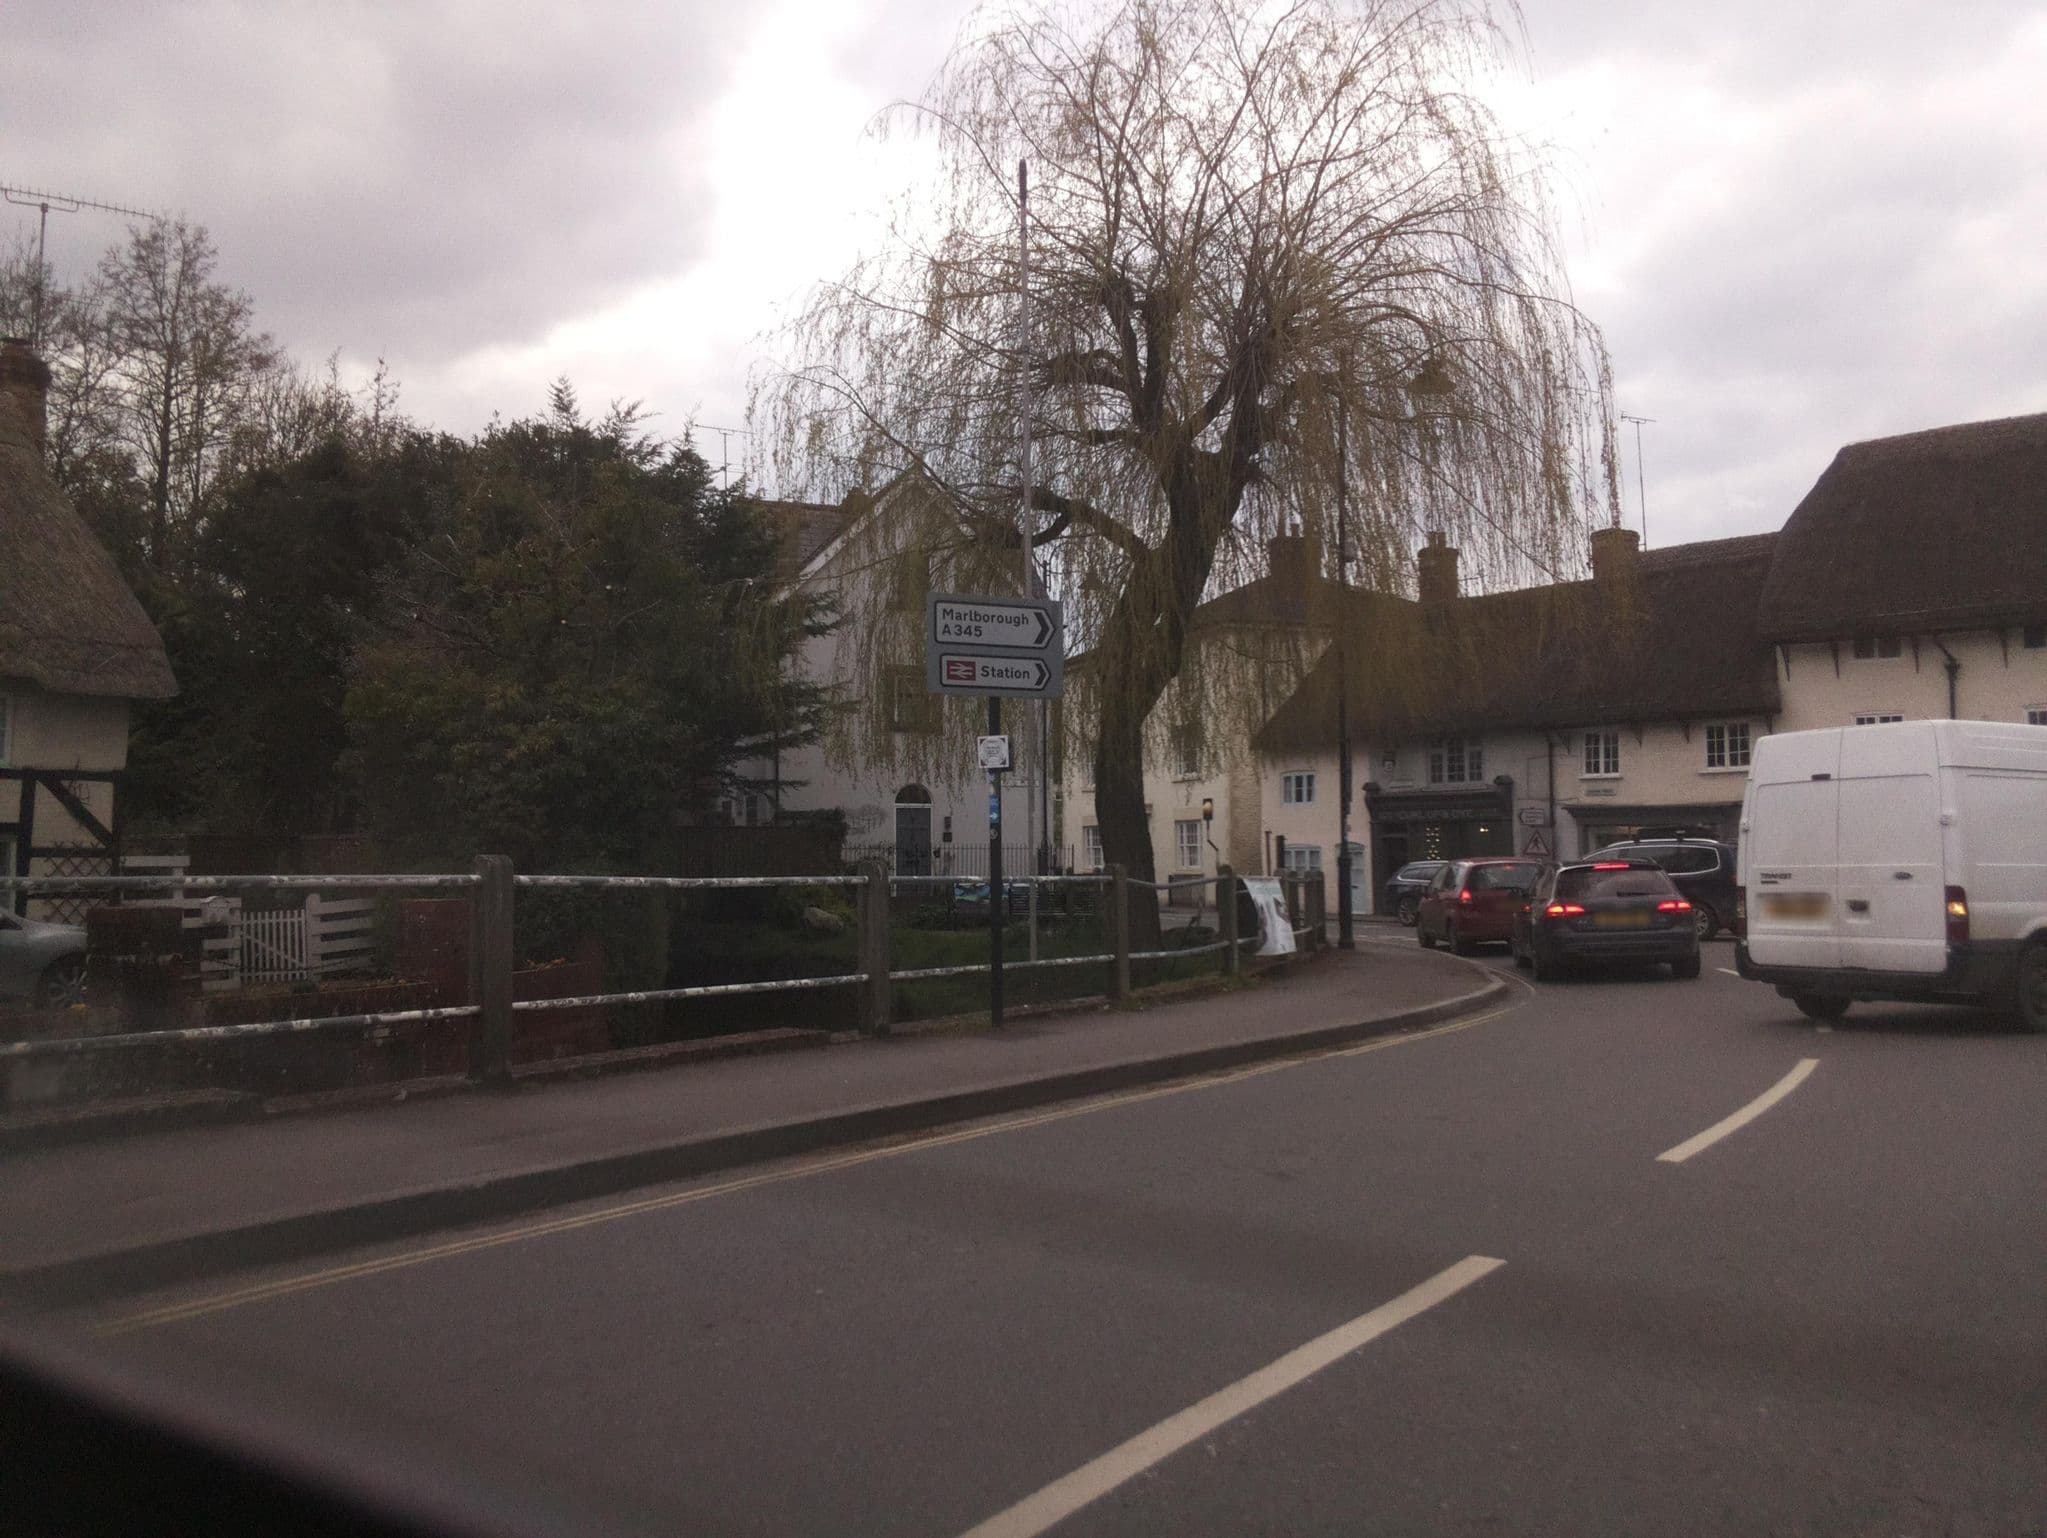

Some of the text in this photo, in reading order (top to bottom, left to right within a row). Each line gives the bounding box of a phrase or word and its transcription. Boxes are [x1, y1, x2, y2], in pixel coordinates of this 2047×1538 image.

[942, 608, 1029, 626] Marlborough
[942, 624, 982, 637] A345
[981, 665, 1030, 680] Station
